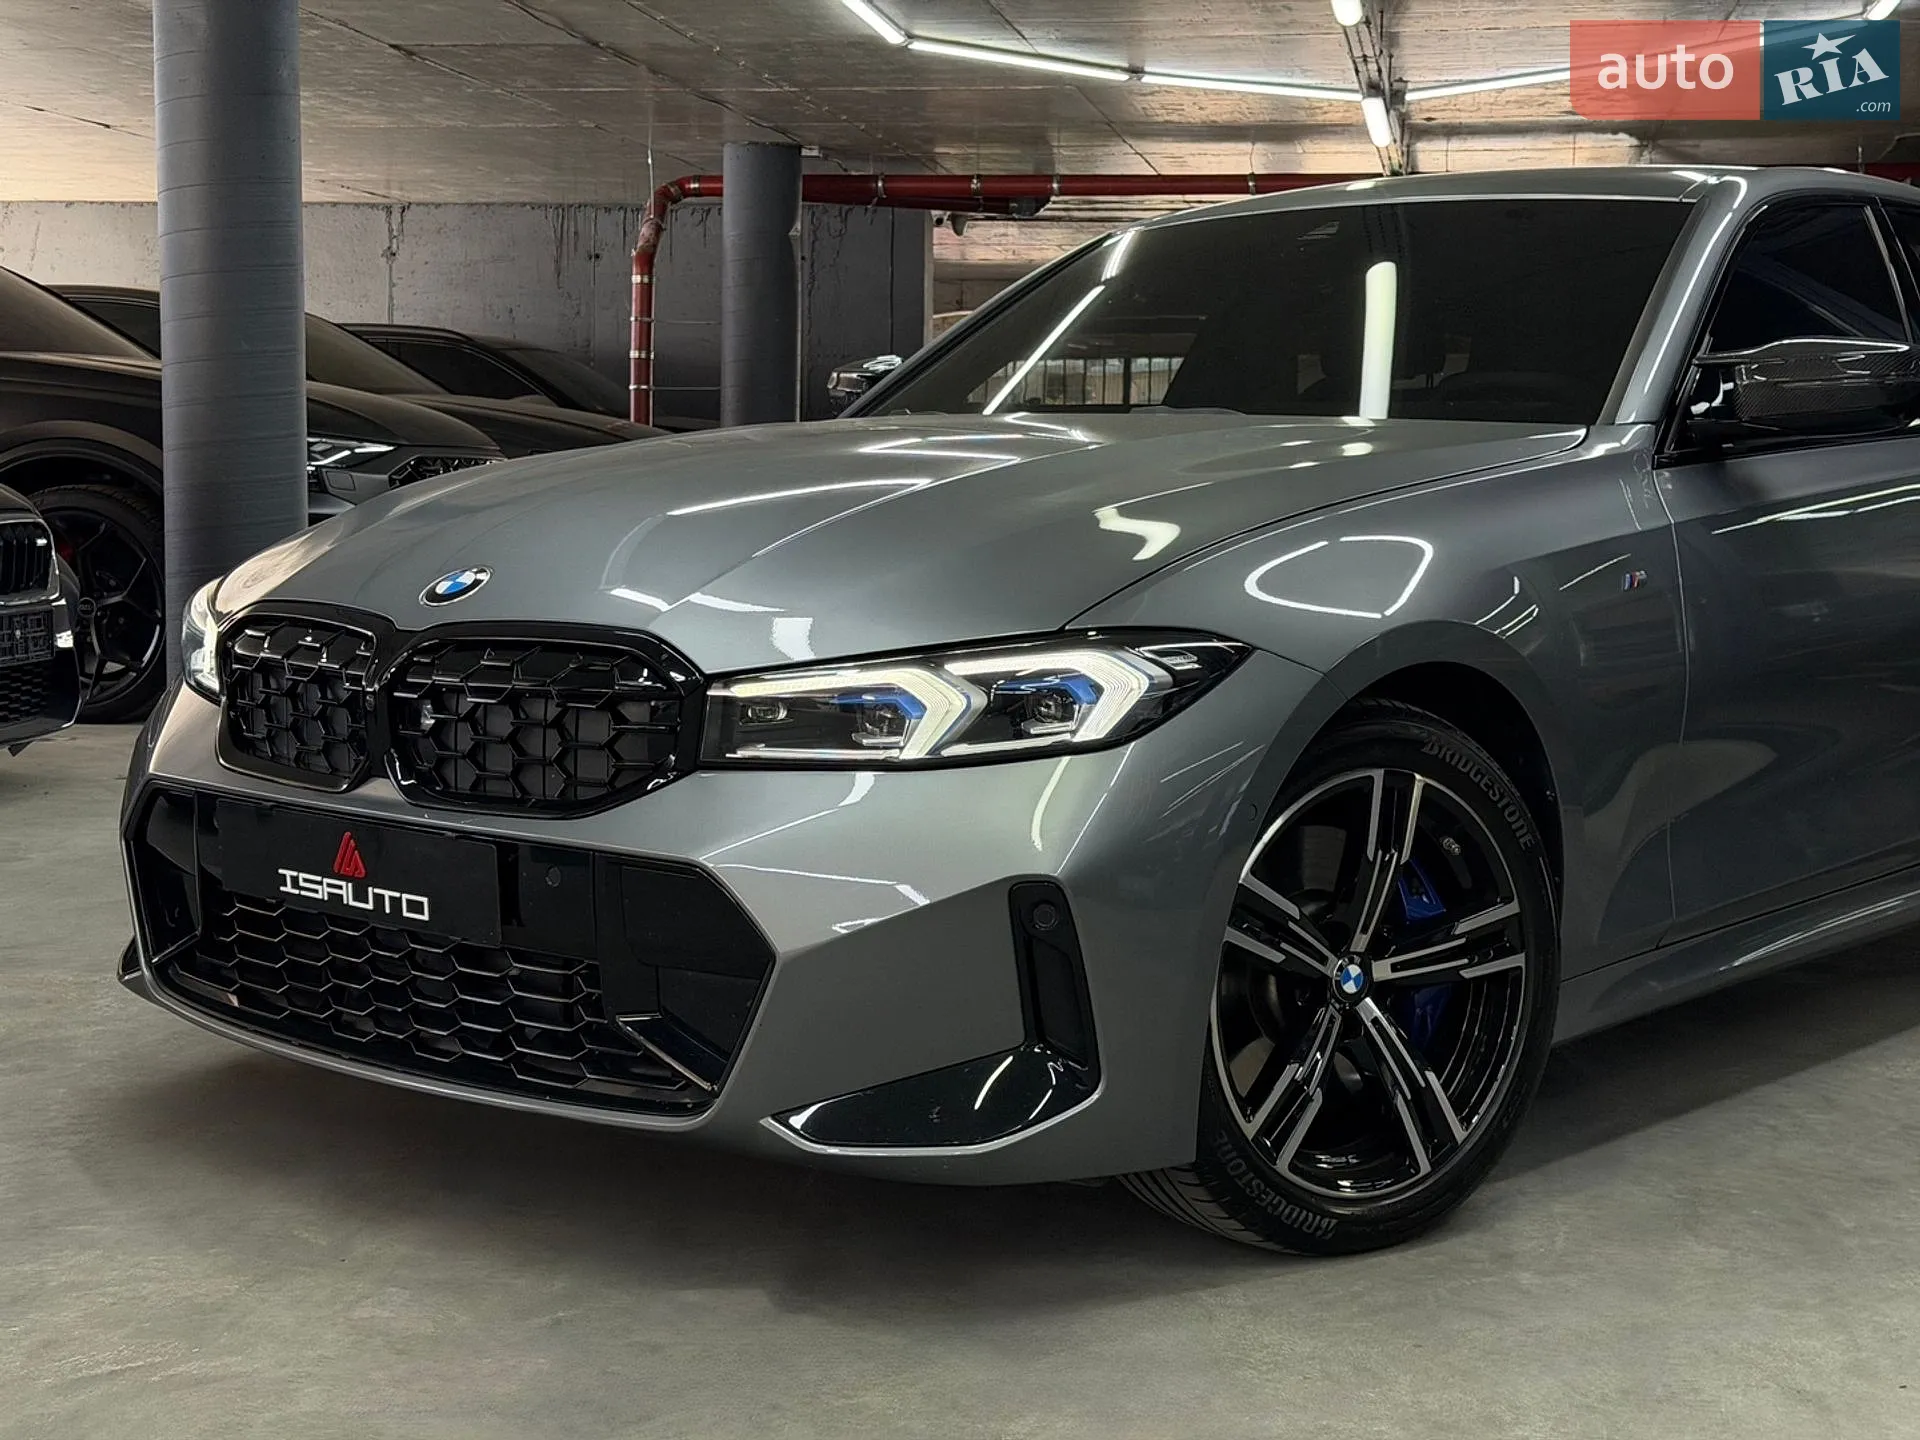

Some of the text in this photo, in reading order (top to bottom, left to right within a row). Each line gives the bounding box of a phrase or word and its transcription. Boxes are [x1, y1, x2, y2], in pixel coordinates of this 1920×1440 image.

[1420, 736, 1536, 852] BRIDGESTONE
[277, 868, 430, 922] ISAUTO
[1213, 1130, 1340, 1241] BRIDGESTONE
